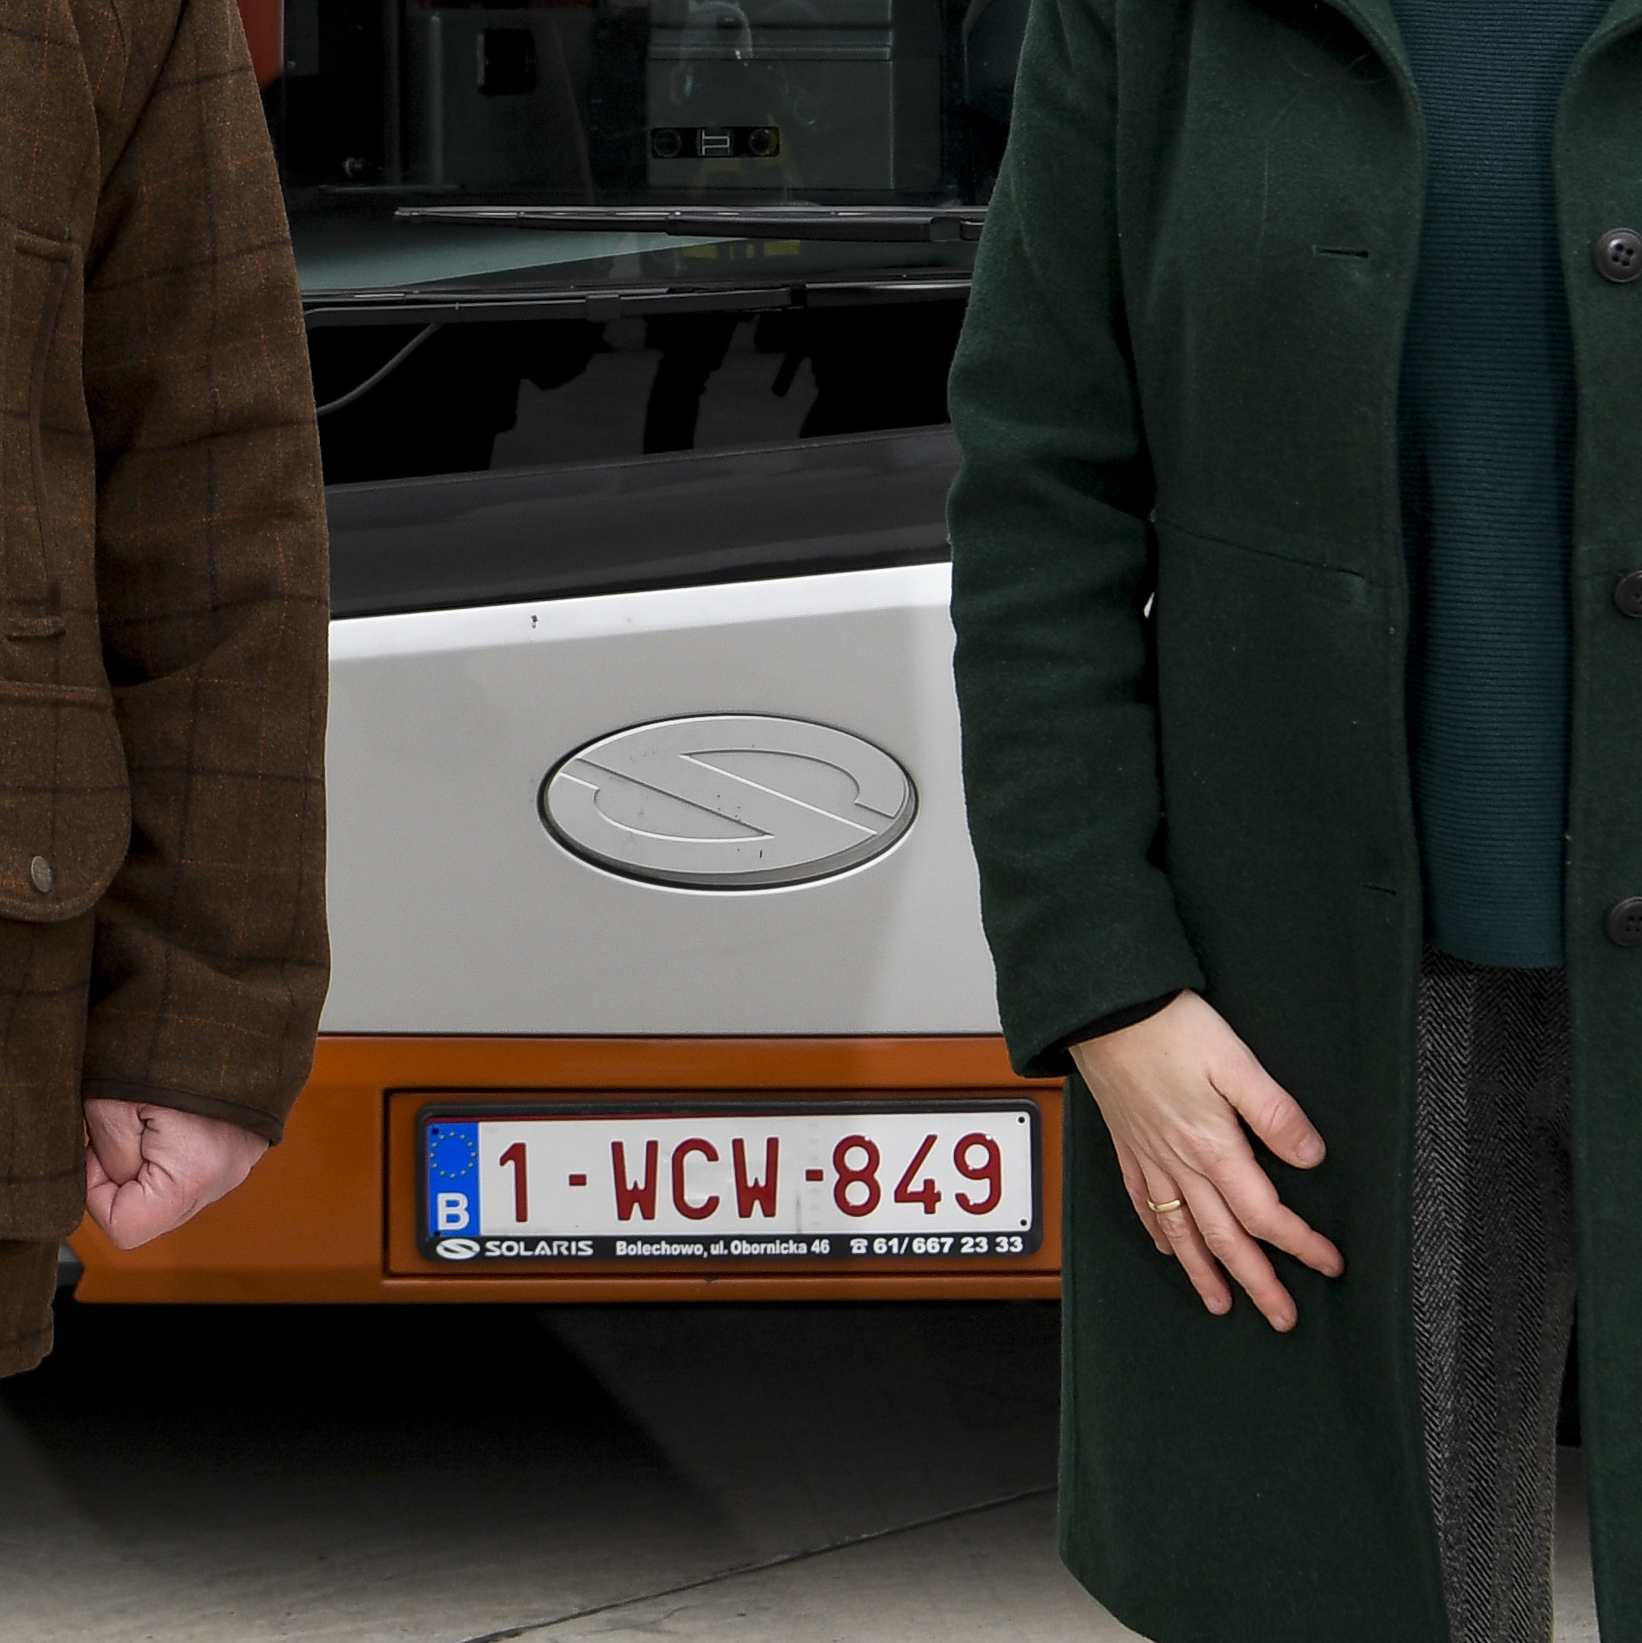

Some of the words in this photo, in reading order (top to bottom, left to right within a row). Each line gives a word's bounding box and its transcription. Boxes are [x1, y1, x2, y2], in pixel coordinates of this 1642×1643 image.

[497, 1131, 1003, 1224] 1-WCW-849
[435, 1192, 471, 1232] B
[484, 1239, 594, 1256] SOLARIS
[615, 1240, 708, 1258] Bolechowo,
[710, 1239, 728, 1255] ul.
[730, 1239, 808, 1256] Obornicka
[810, 1238, 831, 1254] 46
[959, 1236, 989, 1254] 23
[994, 1236, 1024, 1253] 33
